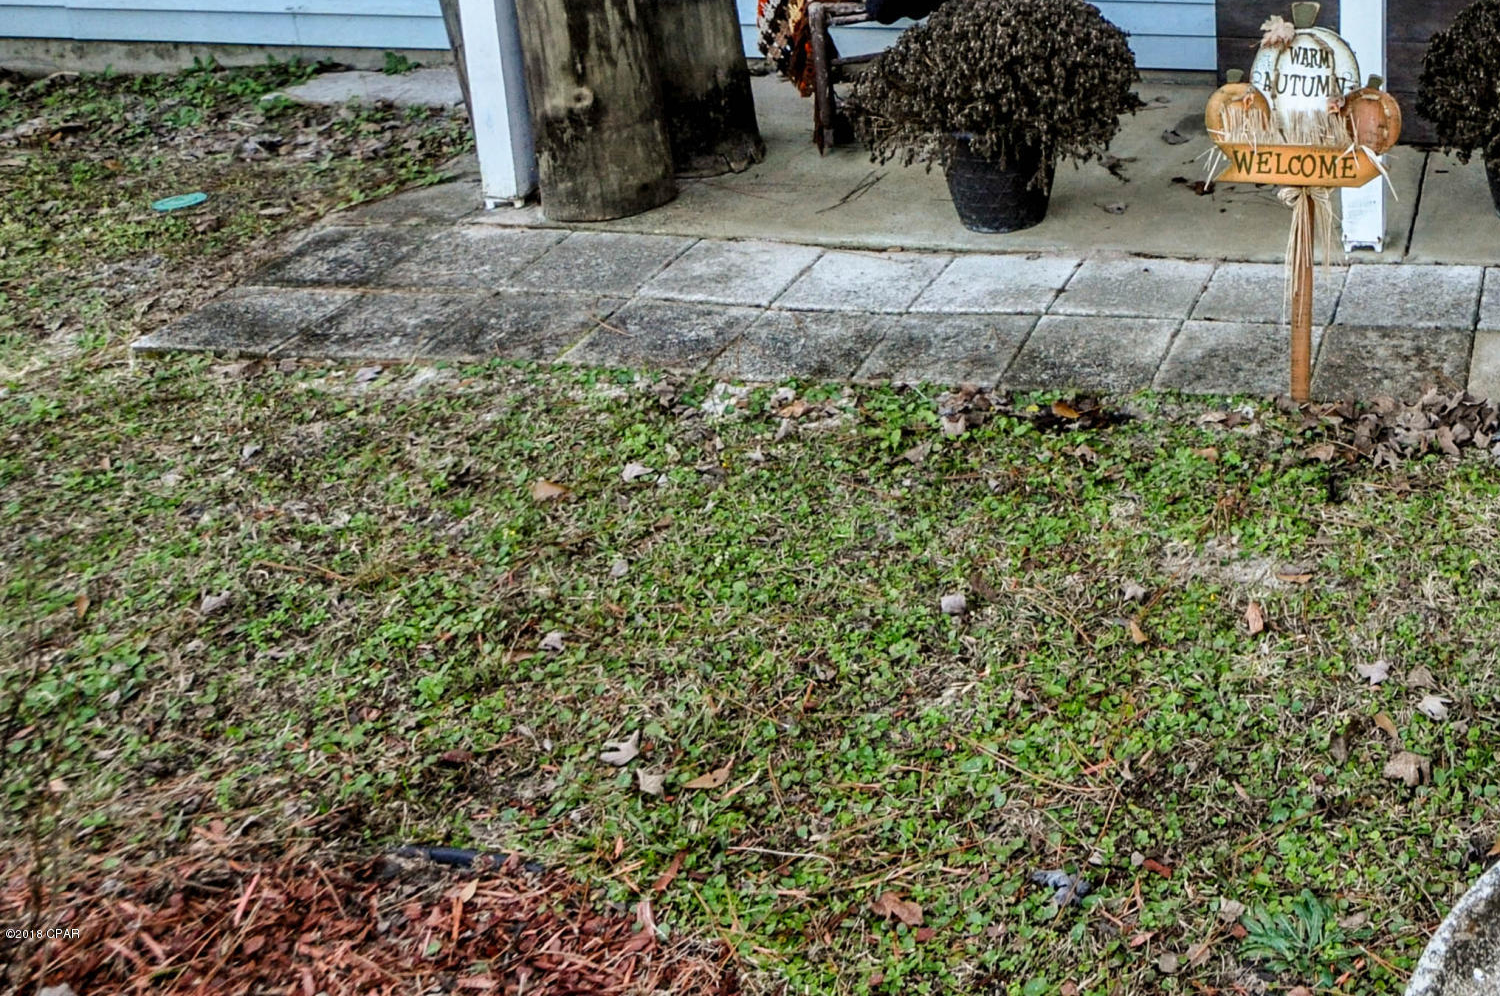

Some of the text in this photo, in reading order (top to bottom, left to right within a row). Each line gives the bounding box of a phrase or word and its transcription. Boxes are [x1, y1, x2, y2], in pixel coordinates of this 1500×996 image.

[1289, 46, 1331, 69] WARM
[1263, 71, 1347, 98] AUTUMN
[1232, 149, 1359, 179] WELCOME
